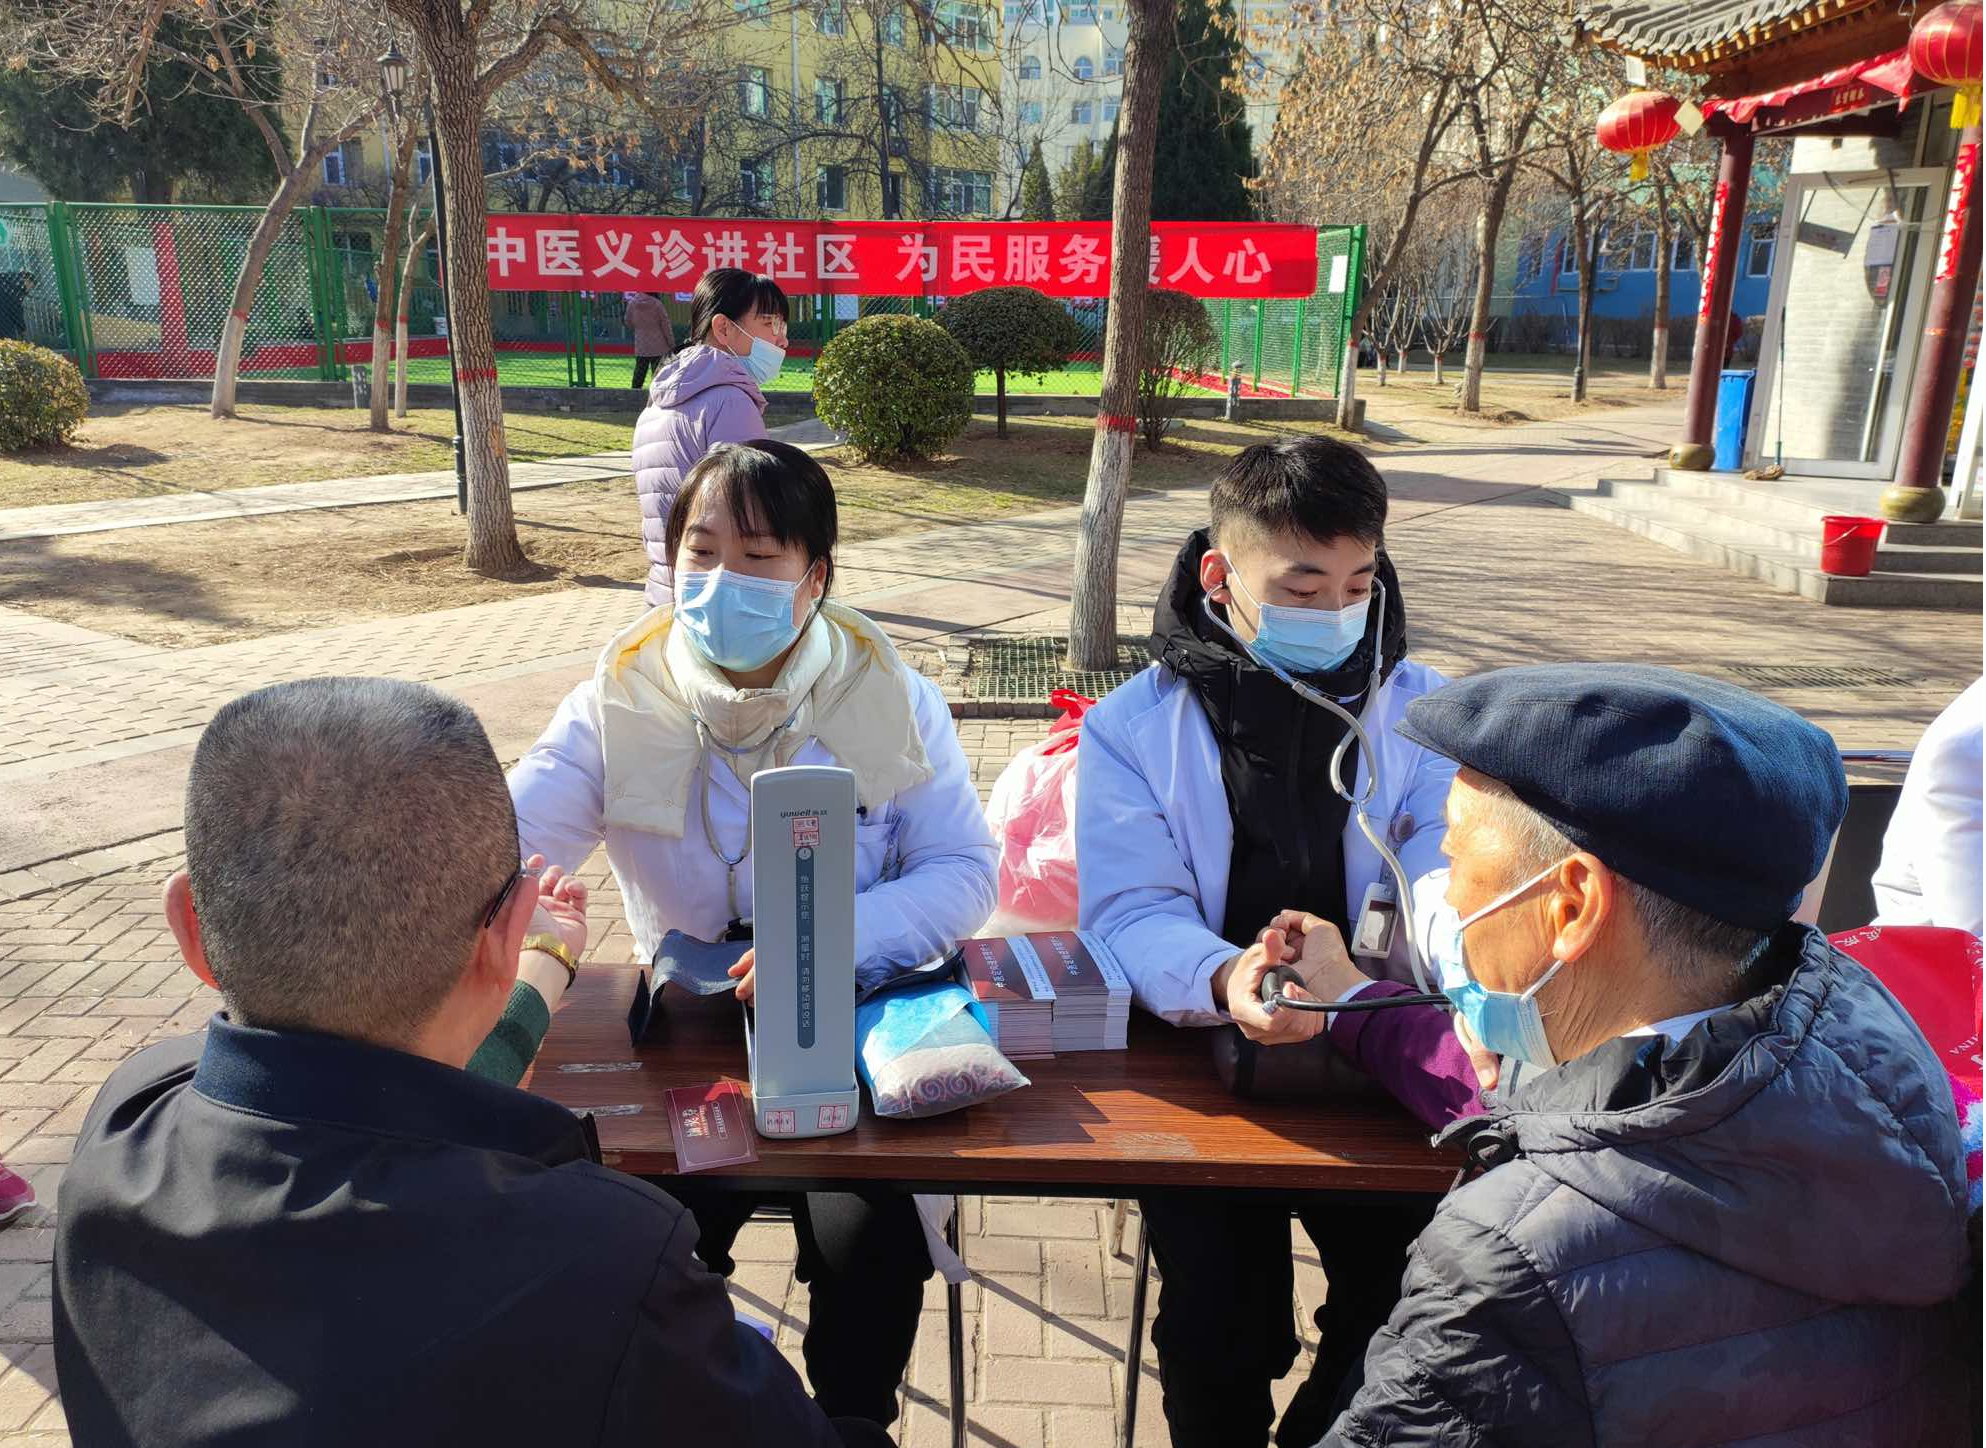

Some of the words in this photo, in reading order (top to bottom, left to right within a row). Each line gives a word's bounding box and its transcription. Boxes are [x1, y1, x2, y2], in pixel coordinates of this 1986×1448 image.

[487, 227, 860, 280] 中医义诊进社区
[895, 232, 1272, 284] 为民服务人心
